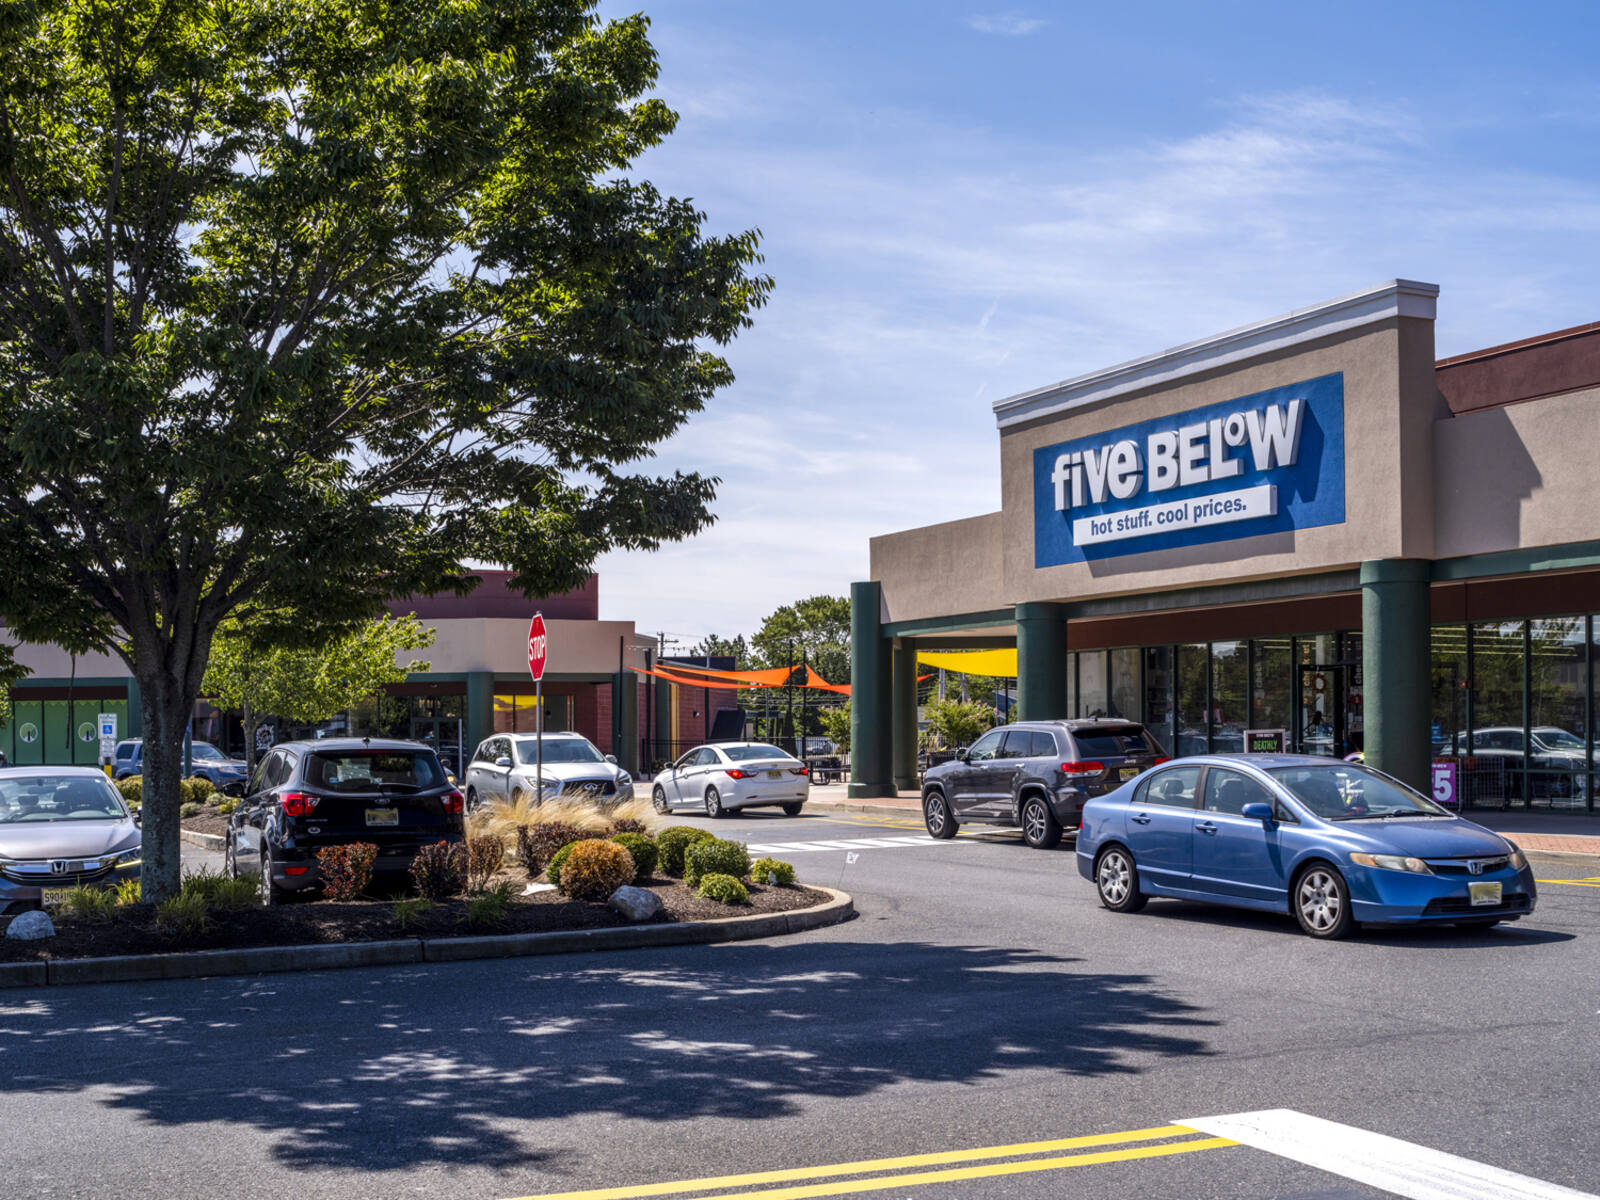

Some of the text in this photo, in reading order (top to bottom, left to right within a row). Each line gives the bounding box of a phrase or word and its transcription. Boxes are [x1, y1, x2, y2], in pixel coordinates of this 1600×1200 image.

[1091, 497, 1247, 536] hot stuff. cool prices.
[529, 635, 545, 661] STOP
